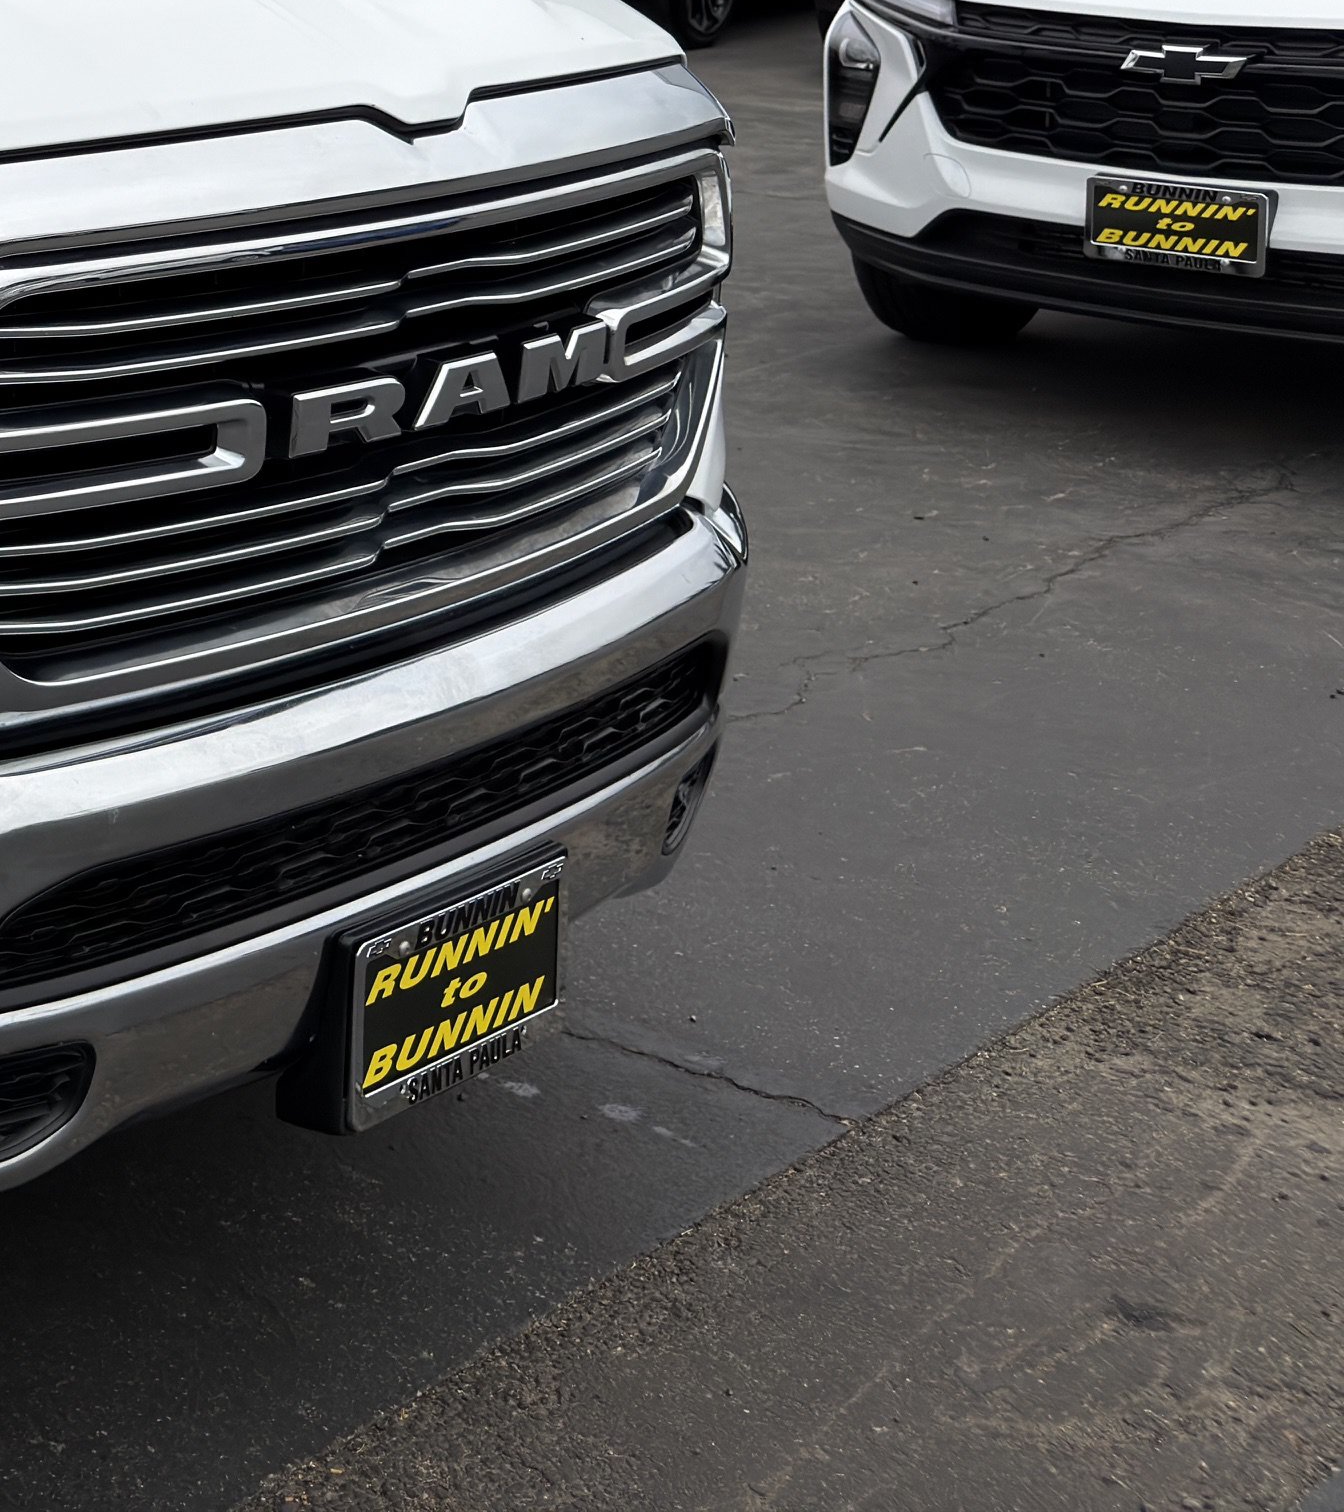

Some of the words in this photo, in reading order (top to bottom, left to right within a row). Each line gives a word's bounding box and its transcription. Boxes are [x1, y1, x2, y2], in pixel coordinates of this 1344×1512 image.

[1098, 193, 1256, 221] RUNNIN'
[1131, 182, 1219, 202] BUNNIN
[1155, 217, 1195, 231] to
[1095, 228, 1248, 258] BUNNIN
[1124, 249, 1172, 266] SANTA
[290, 319, 608, 457] RAM
[413, 880, 521, 949] BUNNIN
[365, 897, 555, 1006] RUNNIN'
[441, 972, 488, 1008] to
[363, 975, 545, 1089] BUNNIN
[408, 1059, 463, 1105] SANTA
[469, 1029, 523, 1075] PAULA
